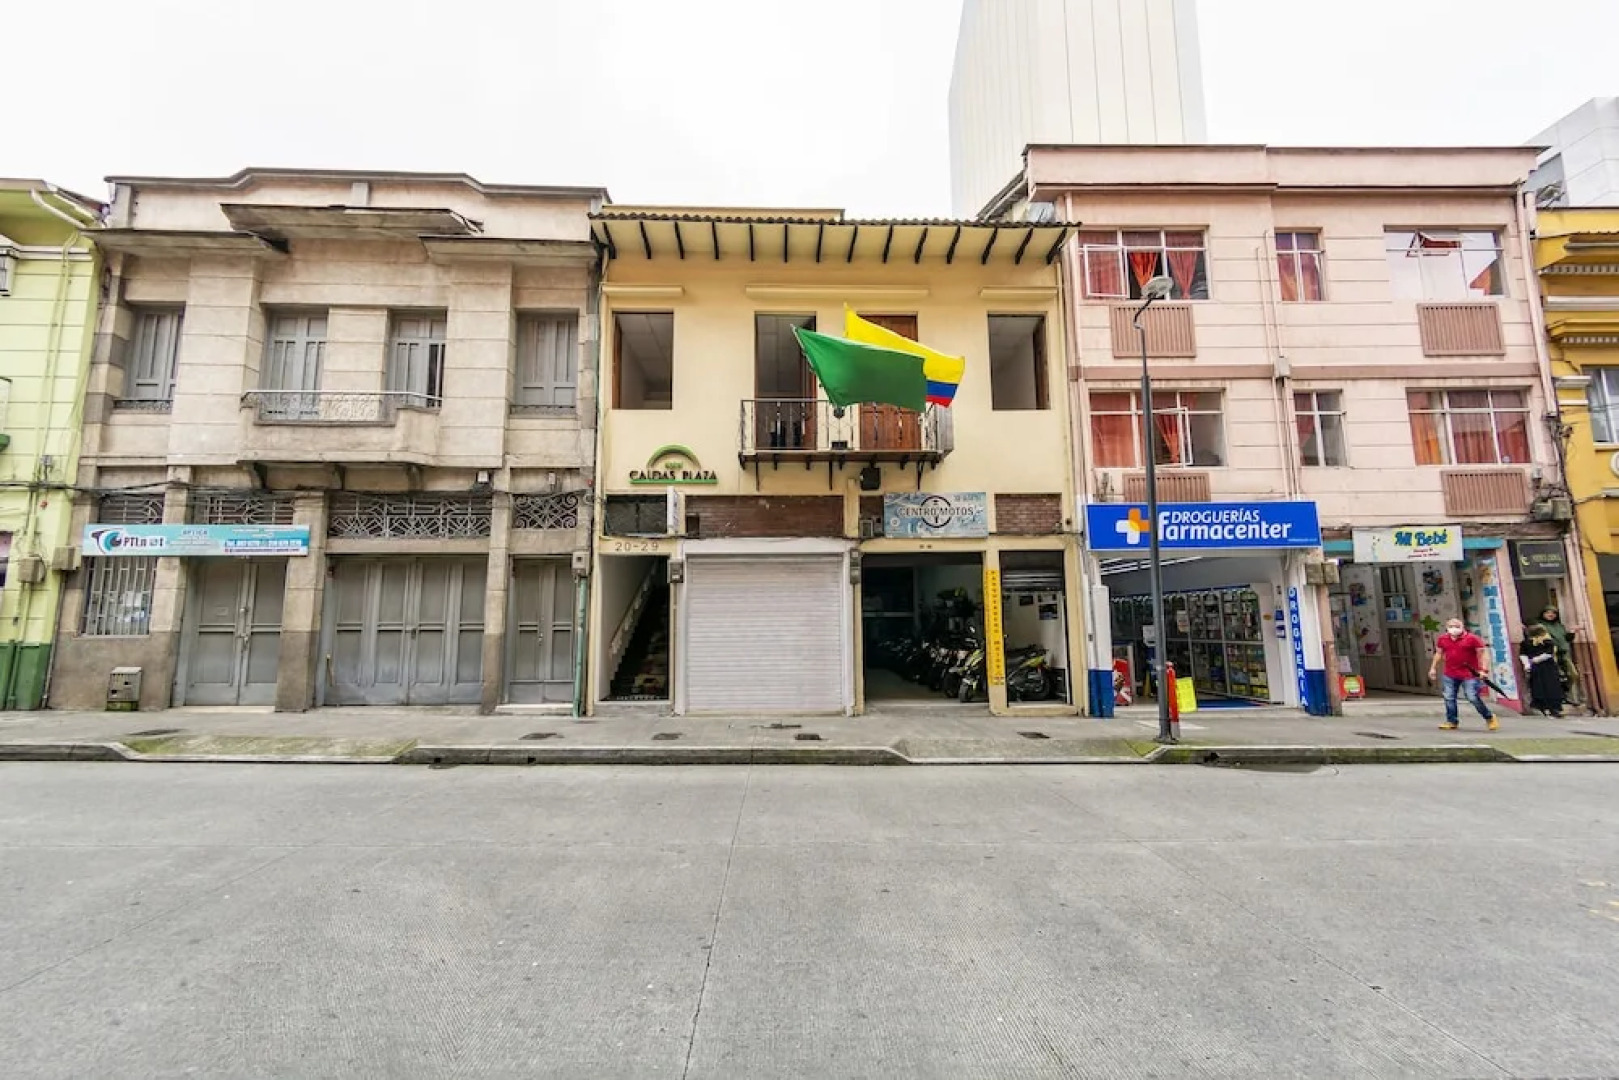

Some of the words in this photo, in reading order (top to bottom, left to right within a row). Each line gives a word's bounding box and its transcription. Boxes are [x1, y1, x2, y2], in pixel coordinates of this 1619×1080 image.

[629, 470, 676, 480] CALDAS
[682, 470, 717, 480] PLAZA
[899, 507, 936, 518] CENTRO
[939, 507, 974, 517] MOTOS
[1171, 509, 1260, 524] DROGUERÍAS
[1158, 511, 1292, 541] farmacenter
[614, 542, 659, 552] 20-29
